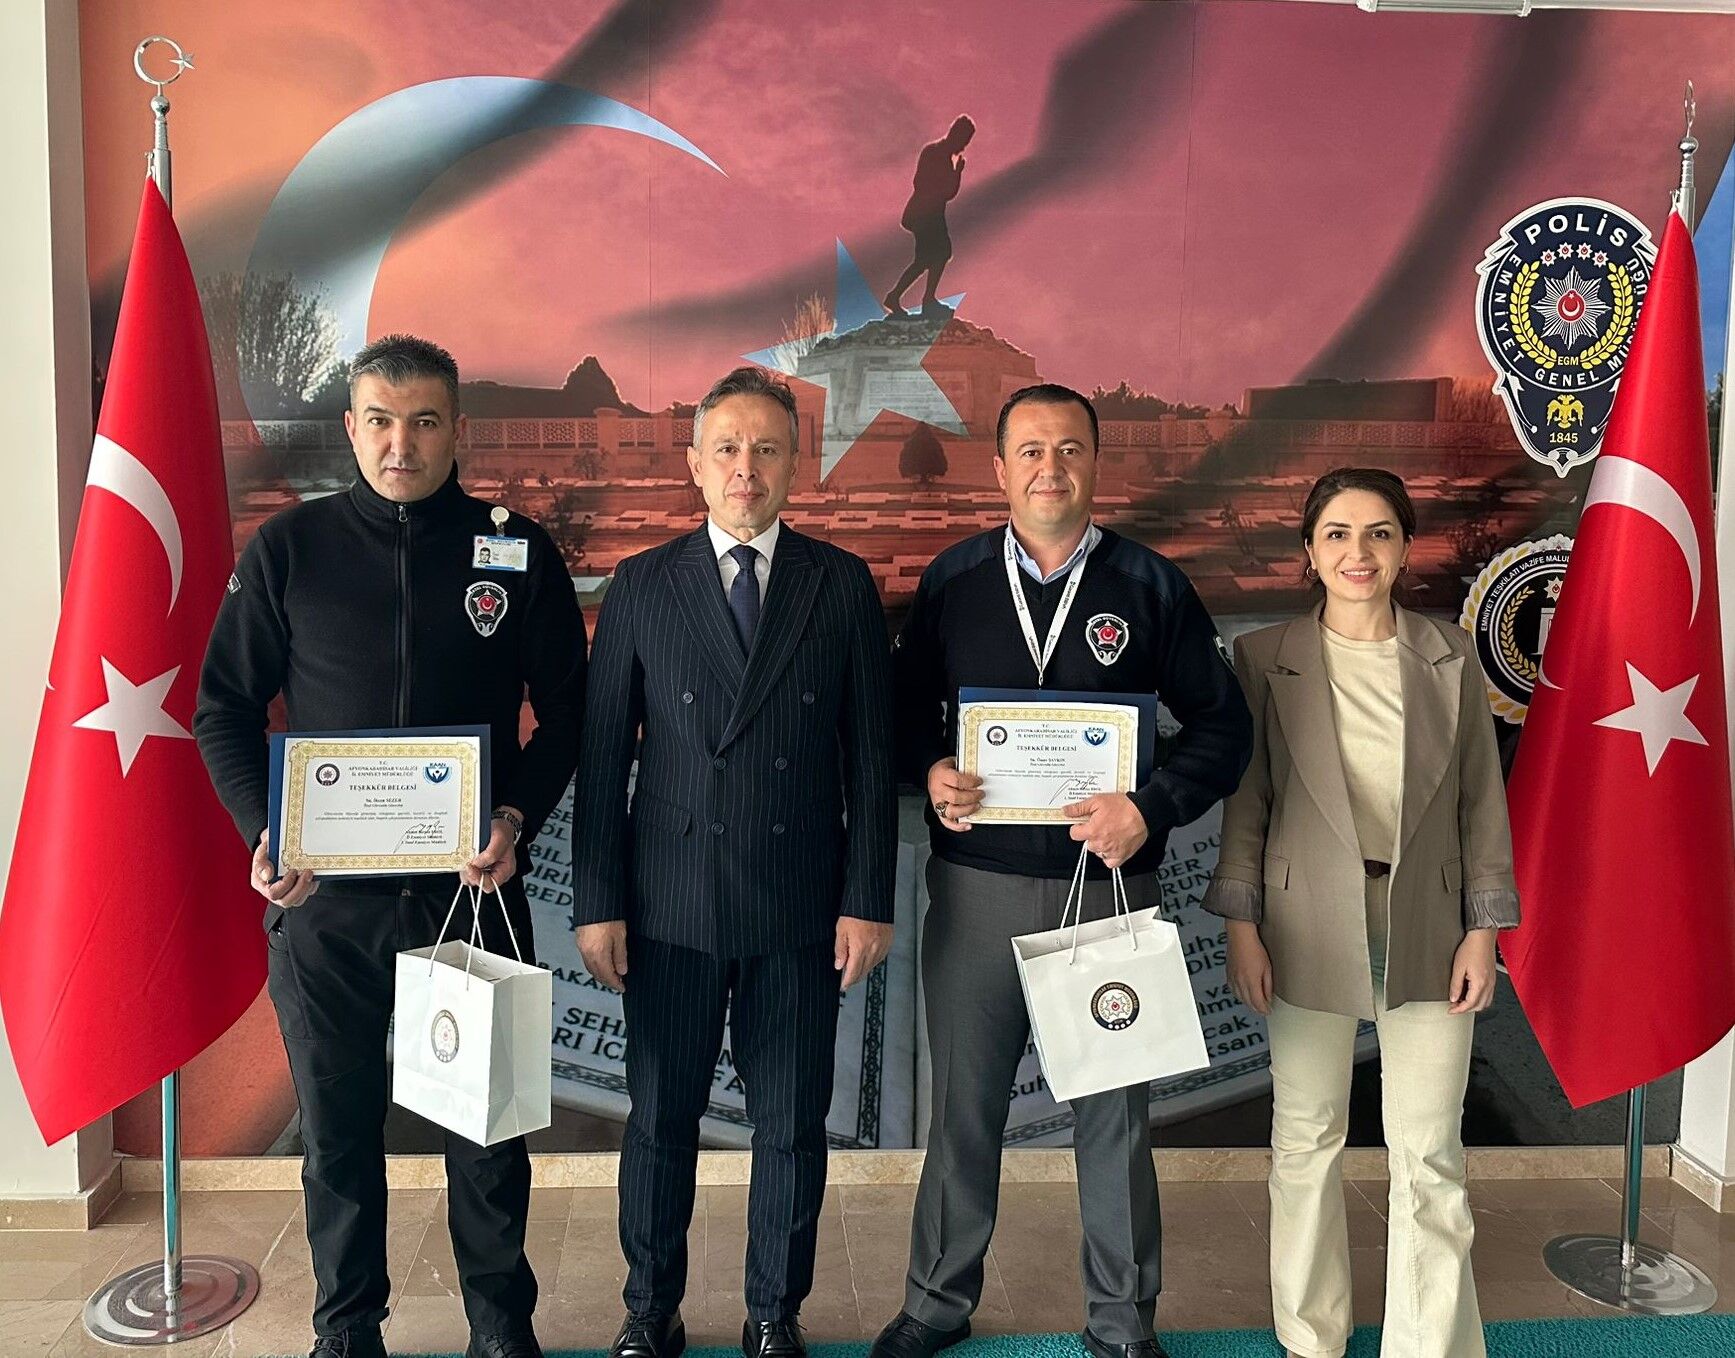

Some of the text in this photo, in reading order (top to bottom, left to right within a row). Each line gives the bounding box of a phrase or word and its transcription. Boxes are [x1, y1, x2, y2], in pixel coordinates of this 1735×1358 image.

[1524, 213, 1628, 247] POLİS
[1493, 253, 1648, 387] EMNİYET GENEL MÜÜĞÜ
[1557, 356, 1579, 367] EGM
[1549, 432, 1579, 444] 1845
[1520, 556, 1545, 571] VAZİFE
[349, 784, 387, 792] TEŞEKKÜR
[529, 844, 572, 867] BİL
[563, 1007, 626, 1039] SEH
